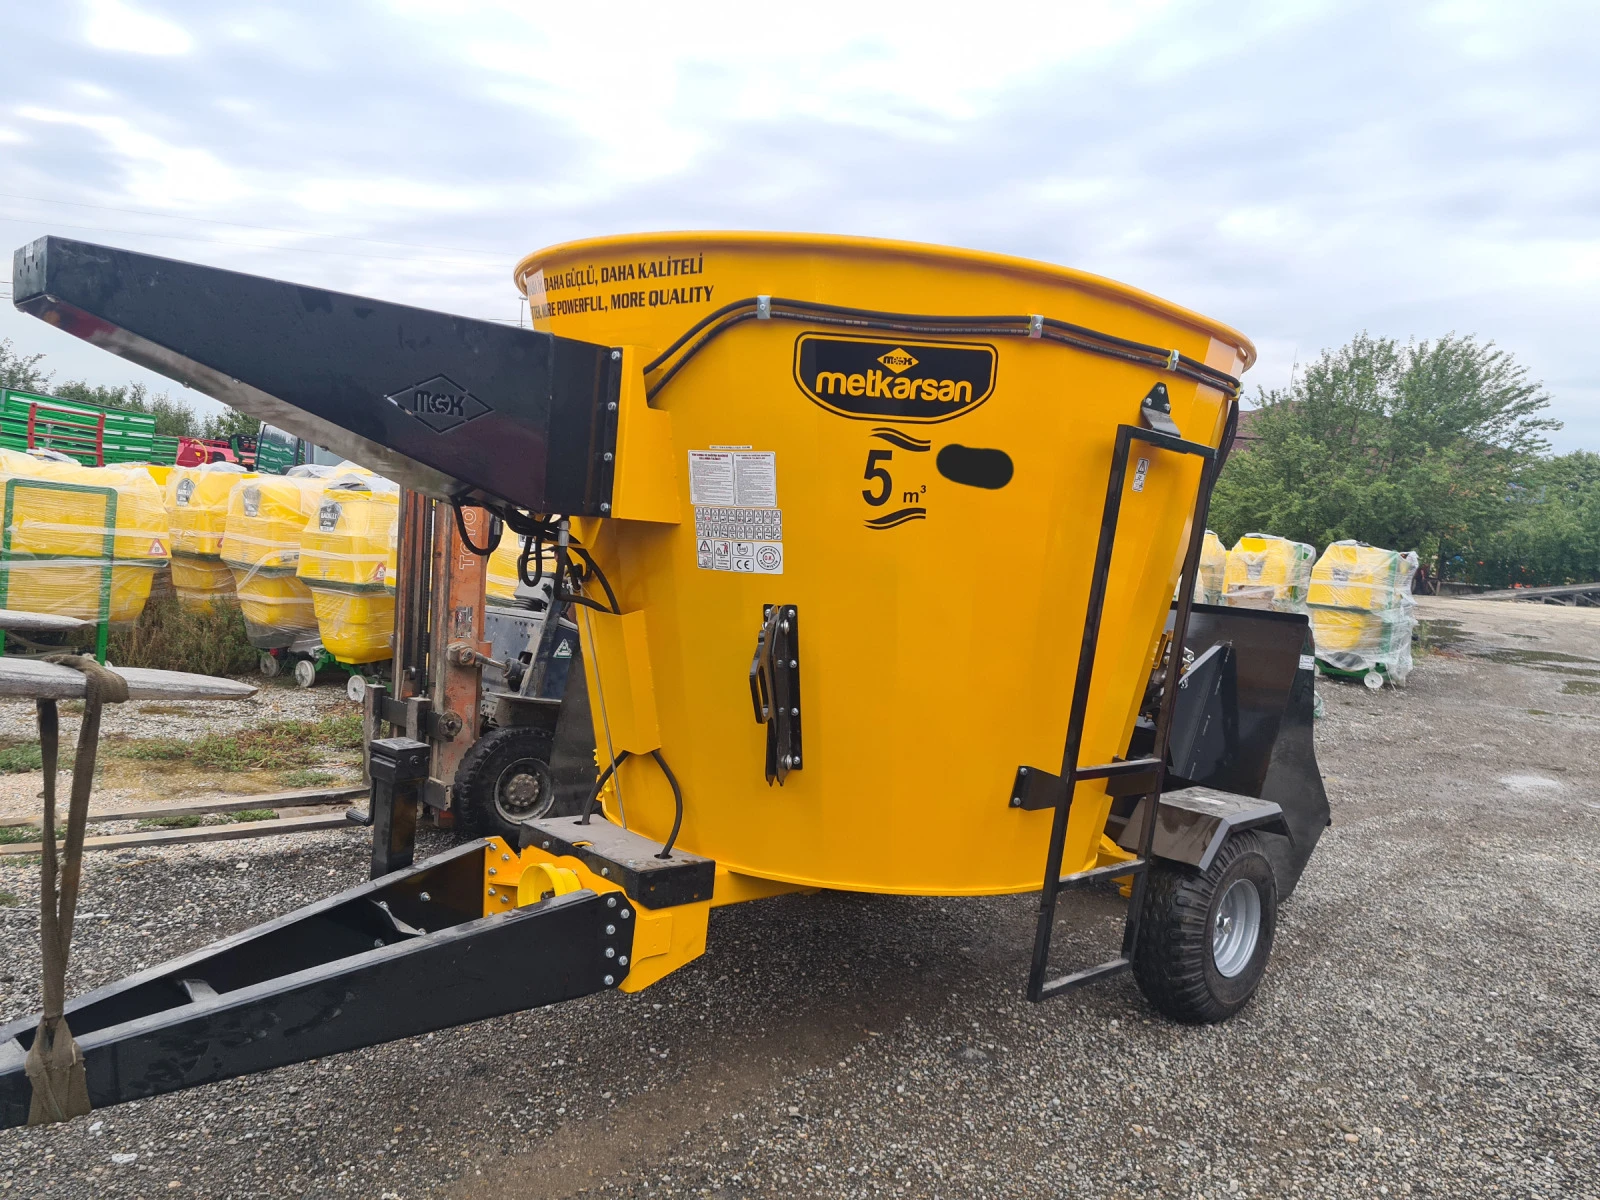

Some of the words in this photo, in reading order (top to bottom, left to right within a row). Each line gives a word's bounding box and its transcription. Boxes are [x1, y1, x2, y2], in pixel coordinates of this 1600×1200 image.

[544, 274, 564, 292] DAHA
[601, 263, 635, 283] DAHA
[638, 252, 703, 280] KALİTELİ
[557, 296, 608, 316] POWERFUL,
[610, 291, 645, 310] MORE
[648, 285, 714, 308] QUALITY
[862, 449, 893, 506] 5
